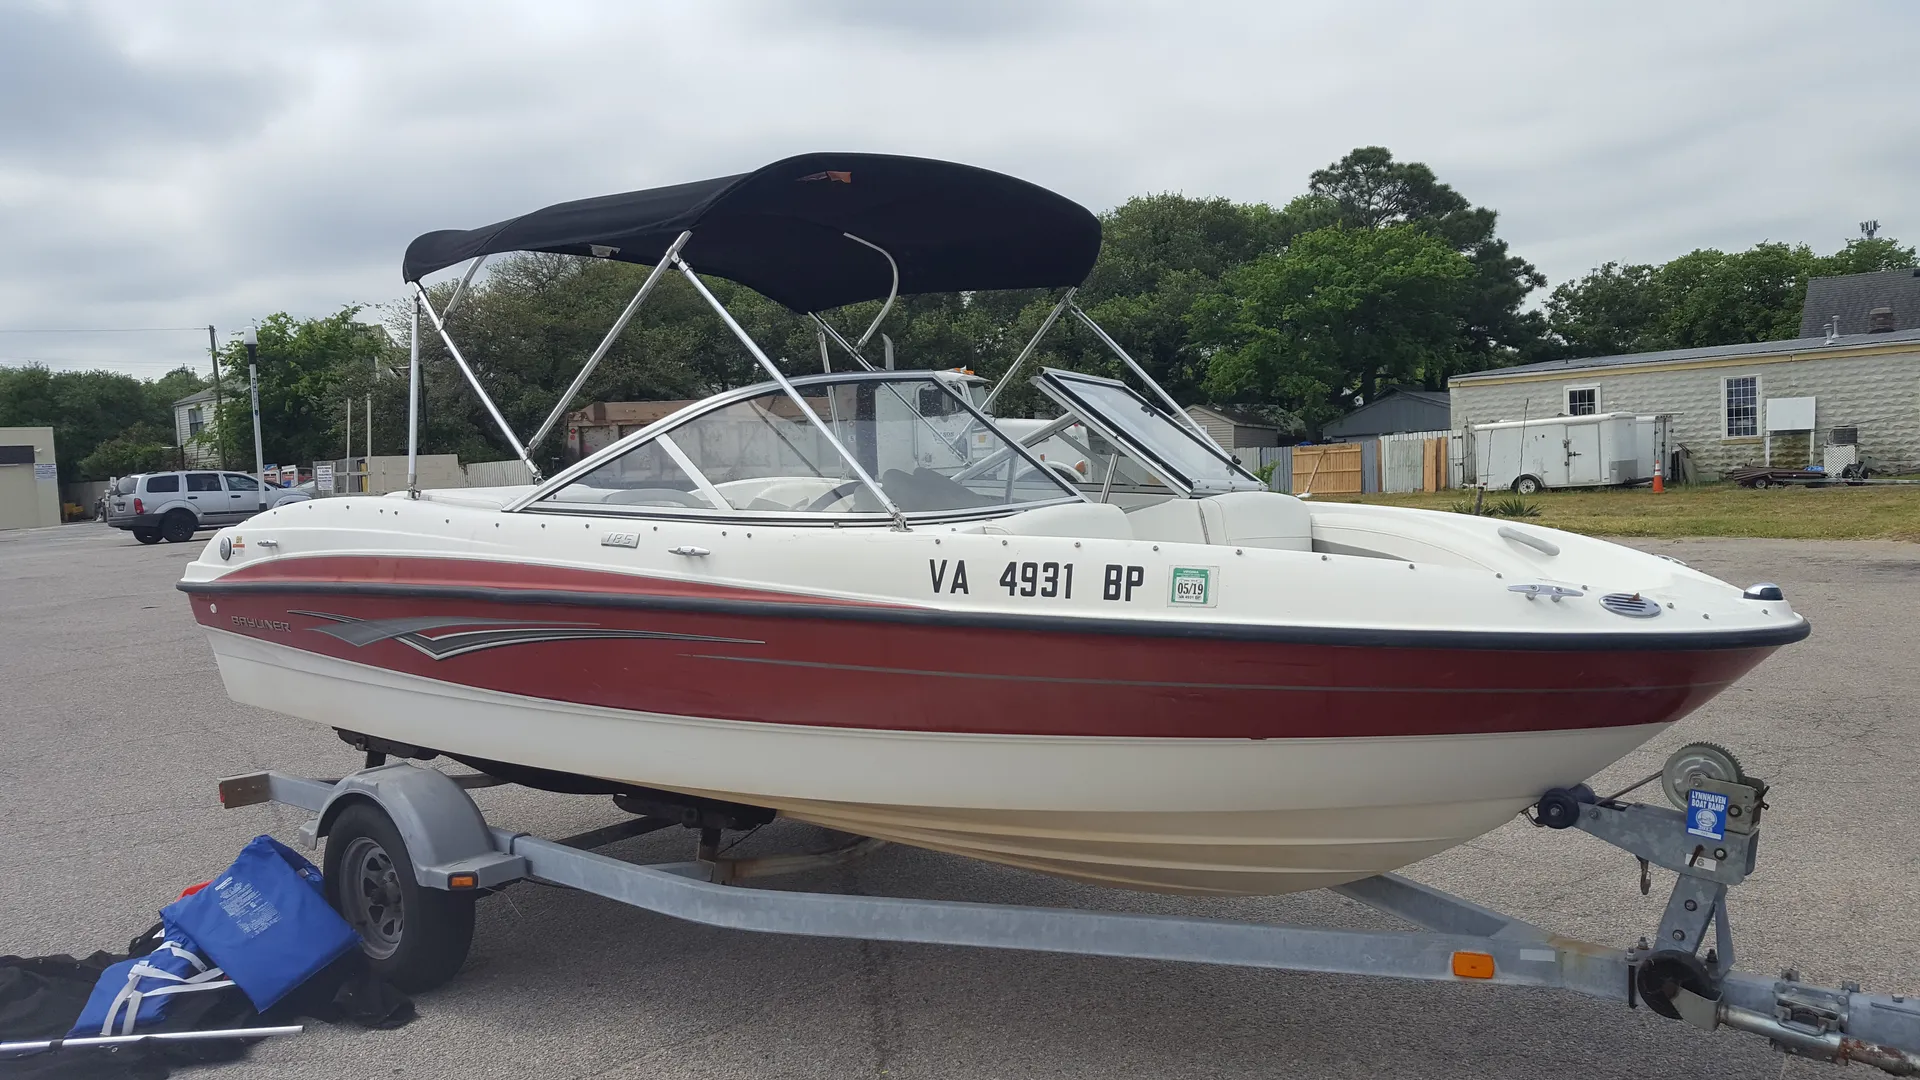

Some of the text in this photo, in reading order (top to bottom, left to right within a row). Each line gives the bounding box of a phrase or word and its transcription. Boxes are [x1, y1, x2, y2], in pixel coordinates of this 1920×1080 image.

[607, 533, 633, 544] 185
[930, 559, 1145, 602] VA 4931 BP
[1177, 582, 1204, 595] 05/19
[231, 616, 291, 632] BAYLINER
[1692, 791, 1727, 804] LYNNHAVEN
[1691, 799, 1725, 812] BOAT RAMP
